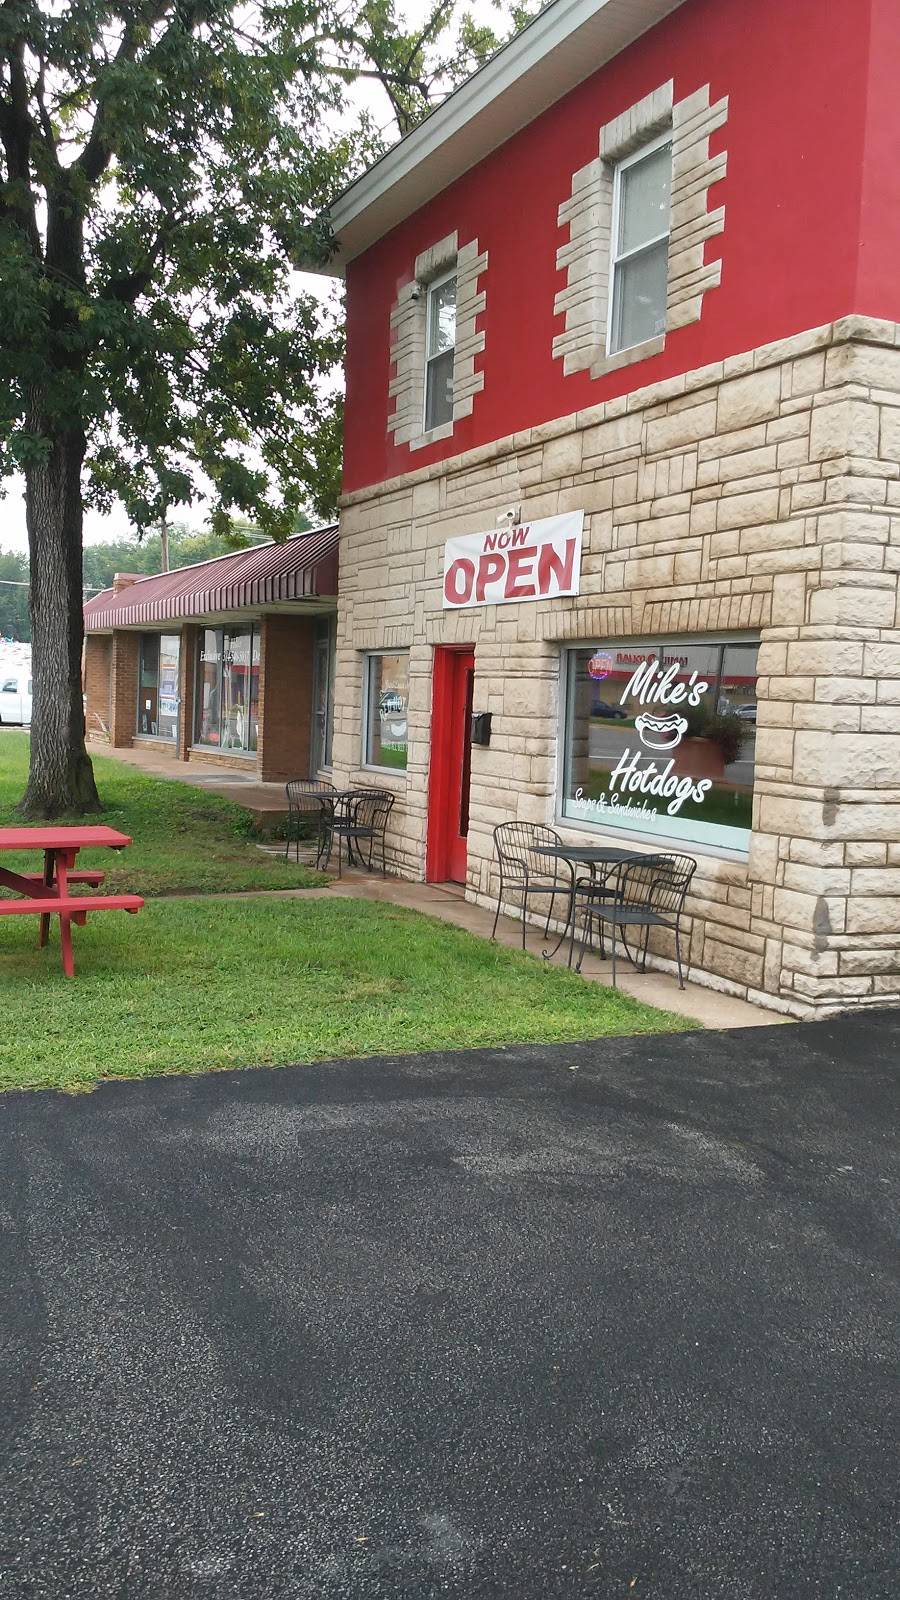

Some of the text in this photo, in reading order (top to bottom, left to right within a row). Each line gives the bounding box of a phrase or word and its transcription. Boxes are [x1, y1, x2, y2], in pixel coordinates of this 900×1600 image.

[483, 526, 530, 552] NOW
[445, 538, 576, 604] OPEN
[619, 660, 708, 706] Mike's
[575, 787, 657, 822] Soups & Sandwiches
[608, 748, 712, 815] Hotdogs
